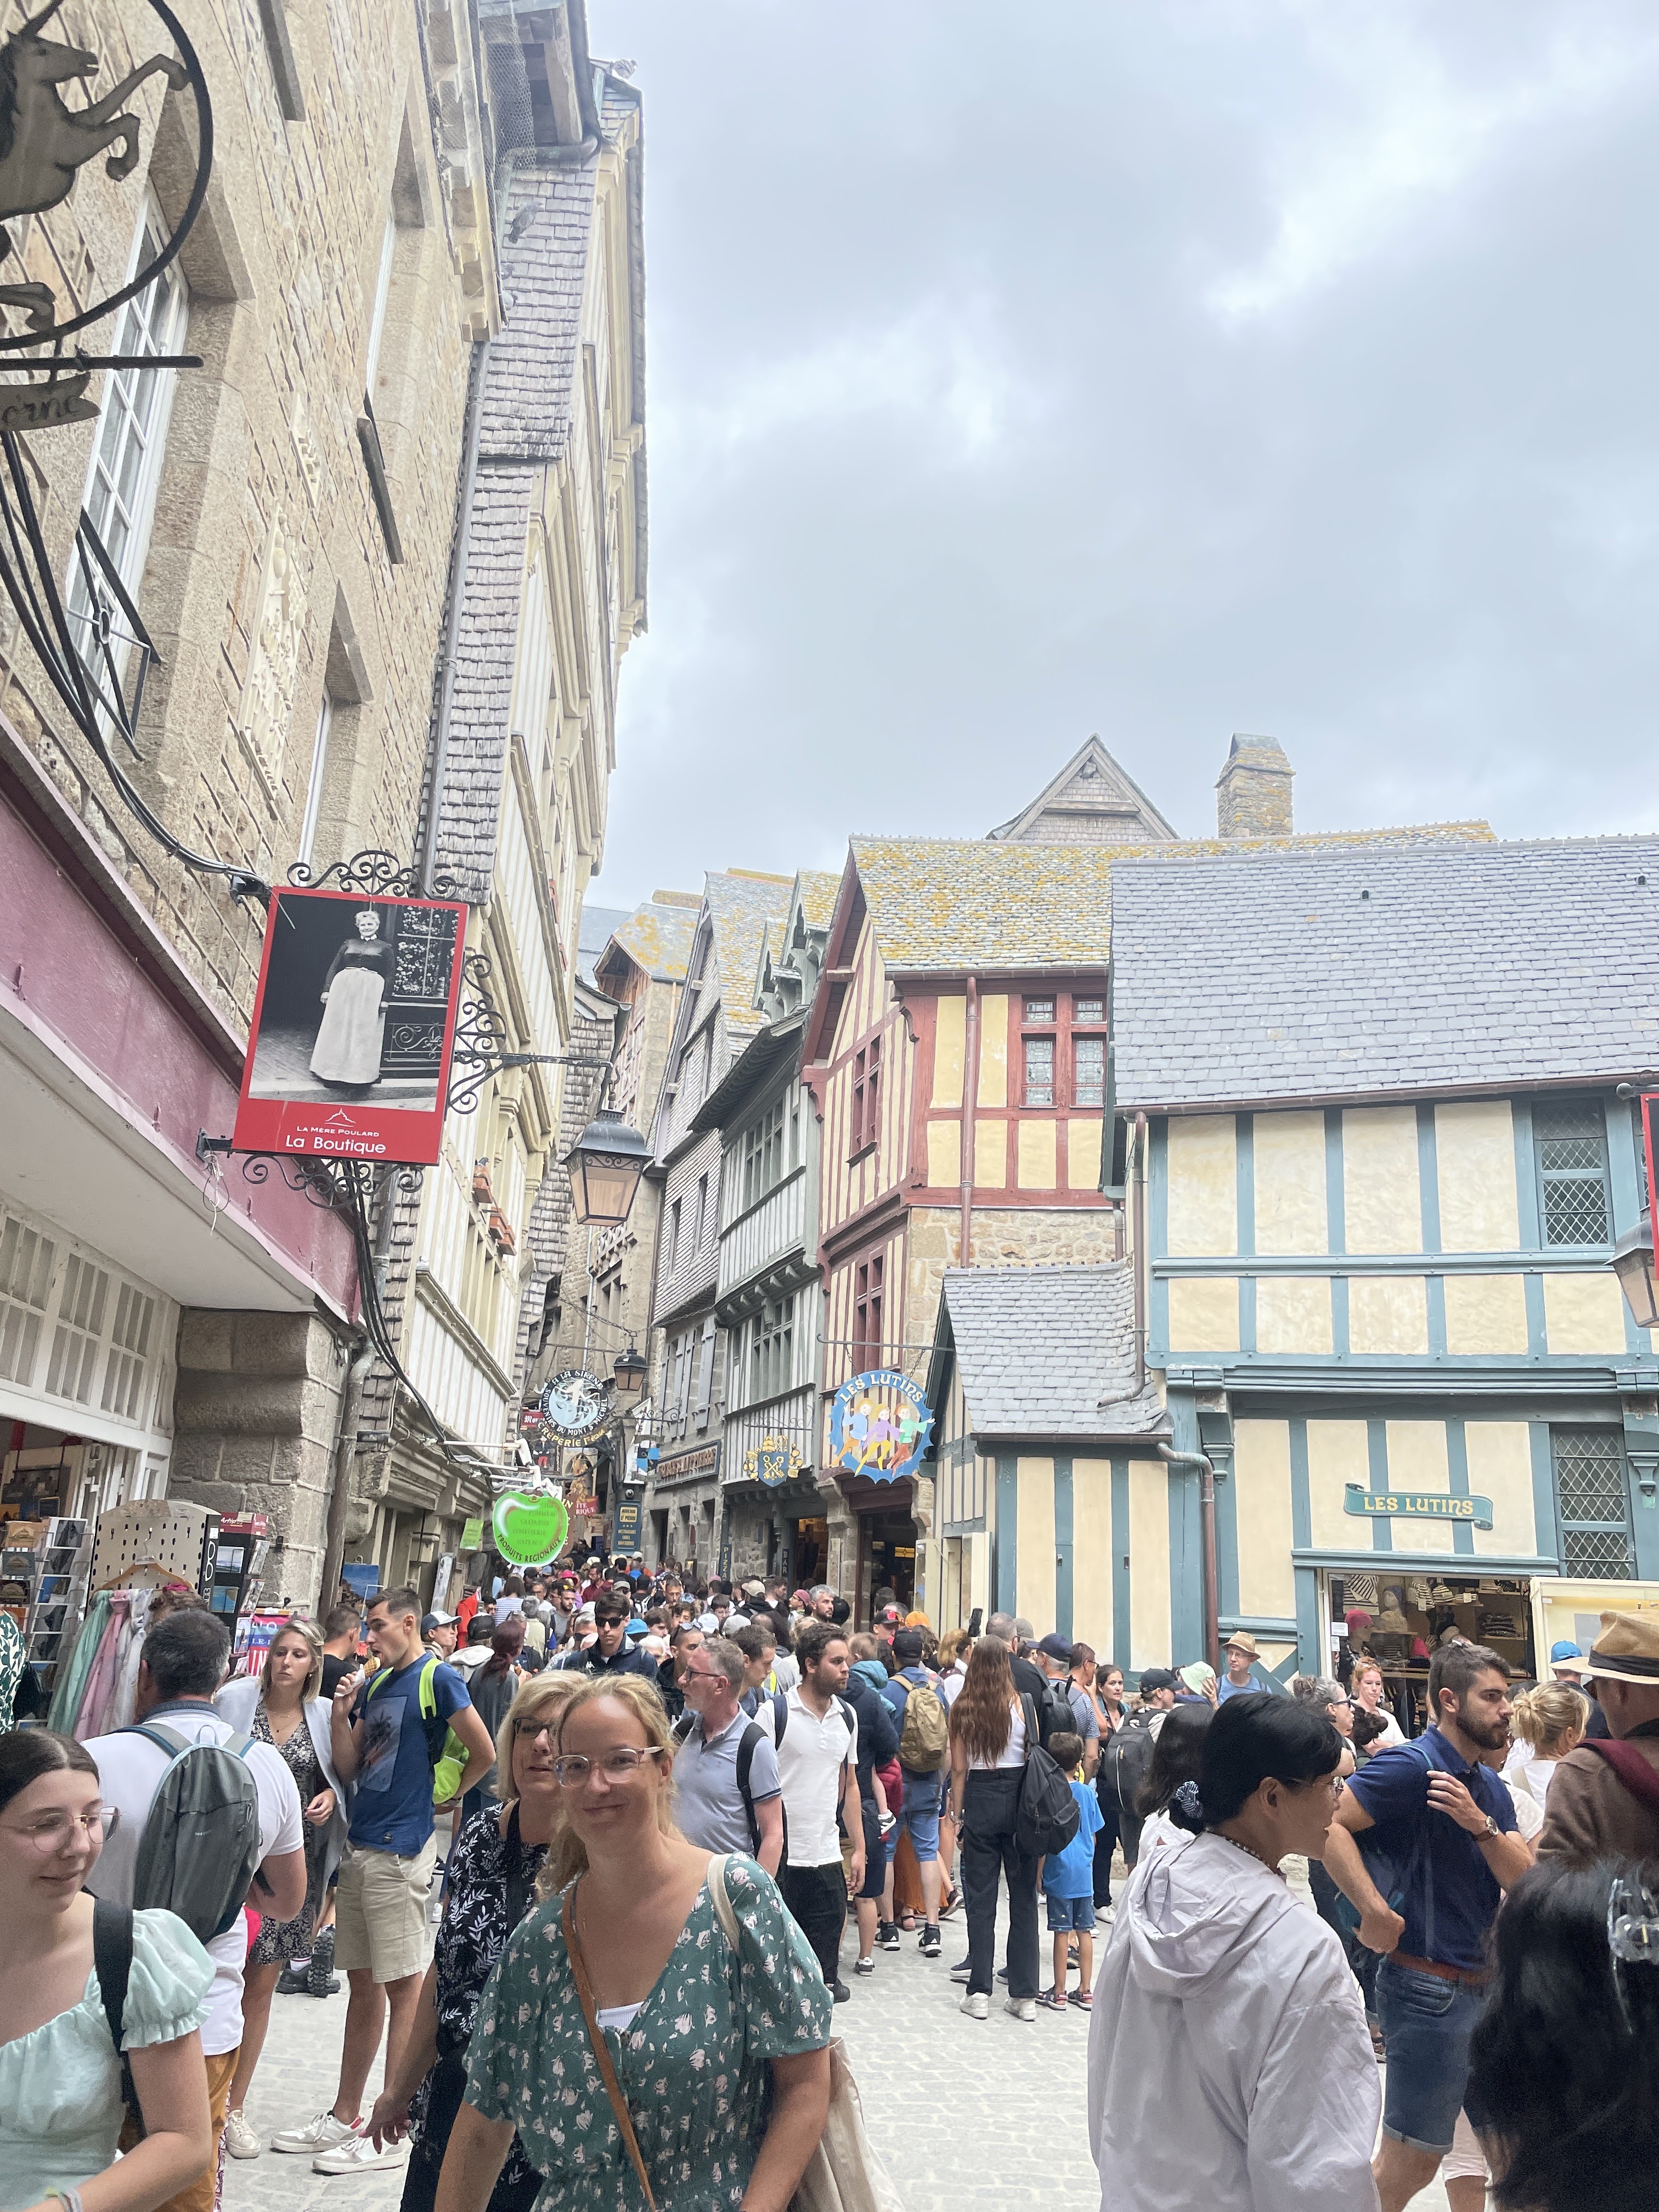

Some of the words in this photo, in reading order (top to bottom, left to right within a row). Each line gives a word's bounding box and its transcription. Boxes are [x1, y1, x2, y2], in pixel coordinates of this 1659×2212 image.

[285, 1135, 305, 1148] La
[313, 1136, 386, 1155] Boutique
[338, 1129, 380, 1137] POULARD
[839, 1378, 865, 1403] LES
[870, 1373, 923, 1403] LUTINS
[542, 1388, 557, 1428] SOUVENIRS
[567, 1427, 586, 1436] MONT
[593, 1397, 608, 1425] MICHEL
[1364, 1497, 1398, 1511] LES
[1405, 1497, 1474, 1516] LUTINS
[498, 1533, 522, 1561] PRODUITS
[524, 1536, 561, 1562] REGIONAUX
